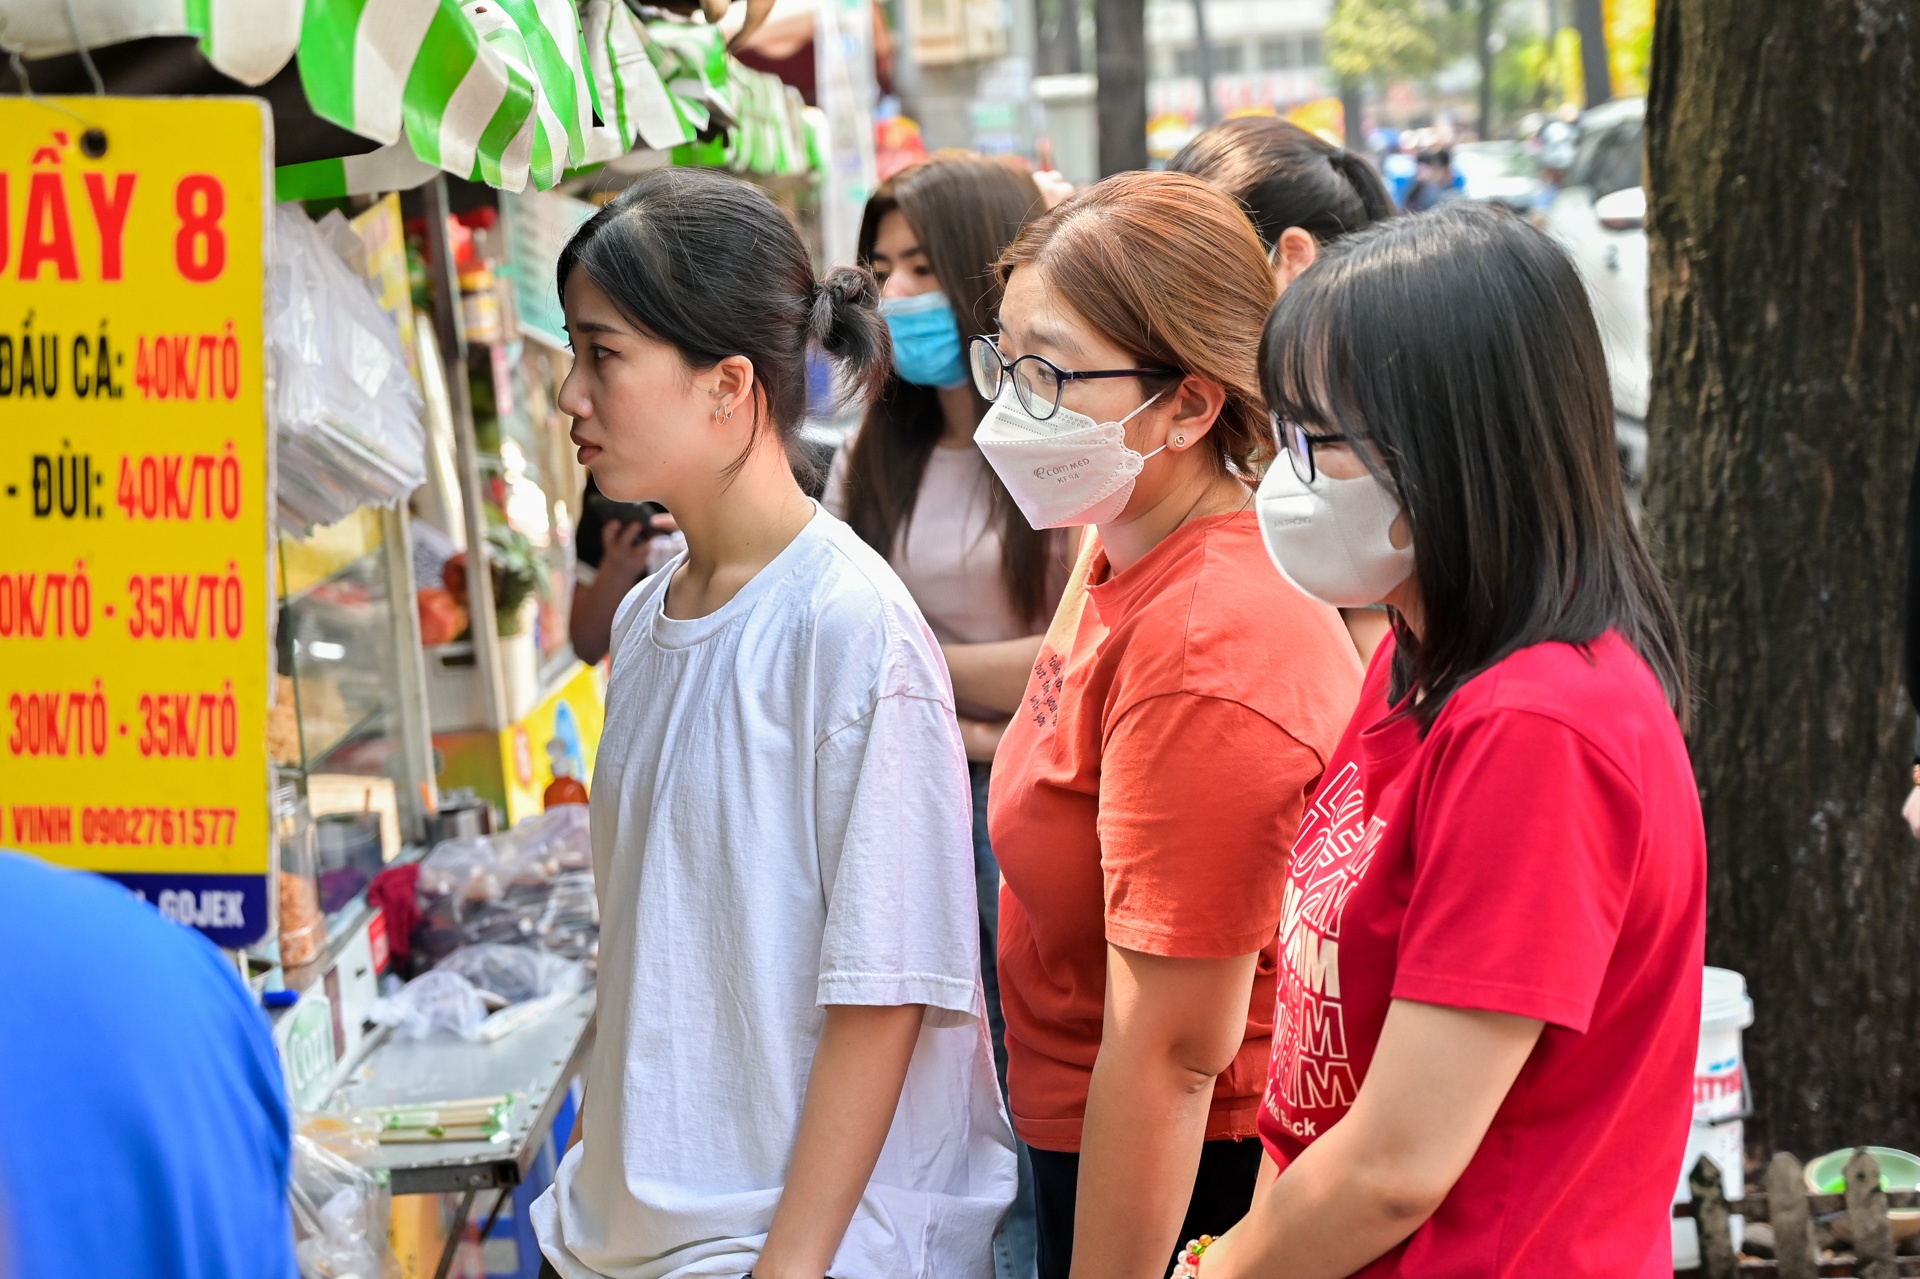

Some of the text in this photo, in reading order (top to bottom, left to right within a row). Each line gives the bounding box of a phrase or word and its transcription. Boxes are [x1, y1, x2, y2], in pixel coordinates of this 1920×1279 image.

[174, 172, 227, 284] 8
[11, 805, 73, 845] VINH
[81, 806, 237, 848] 0902761577
[158, 889, 246, 929] GOJEK
